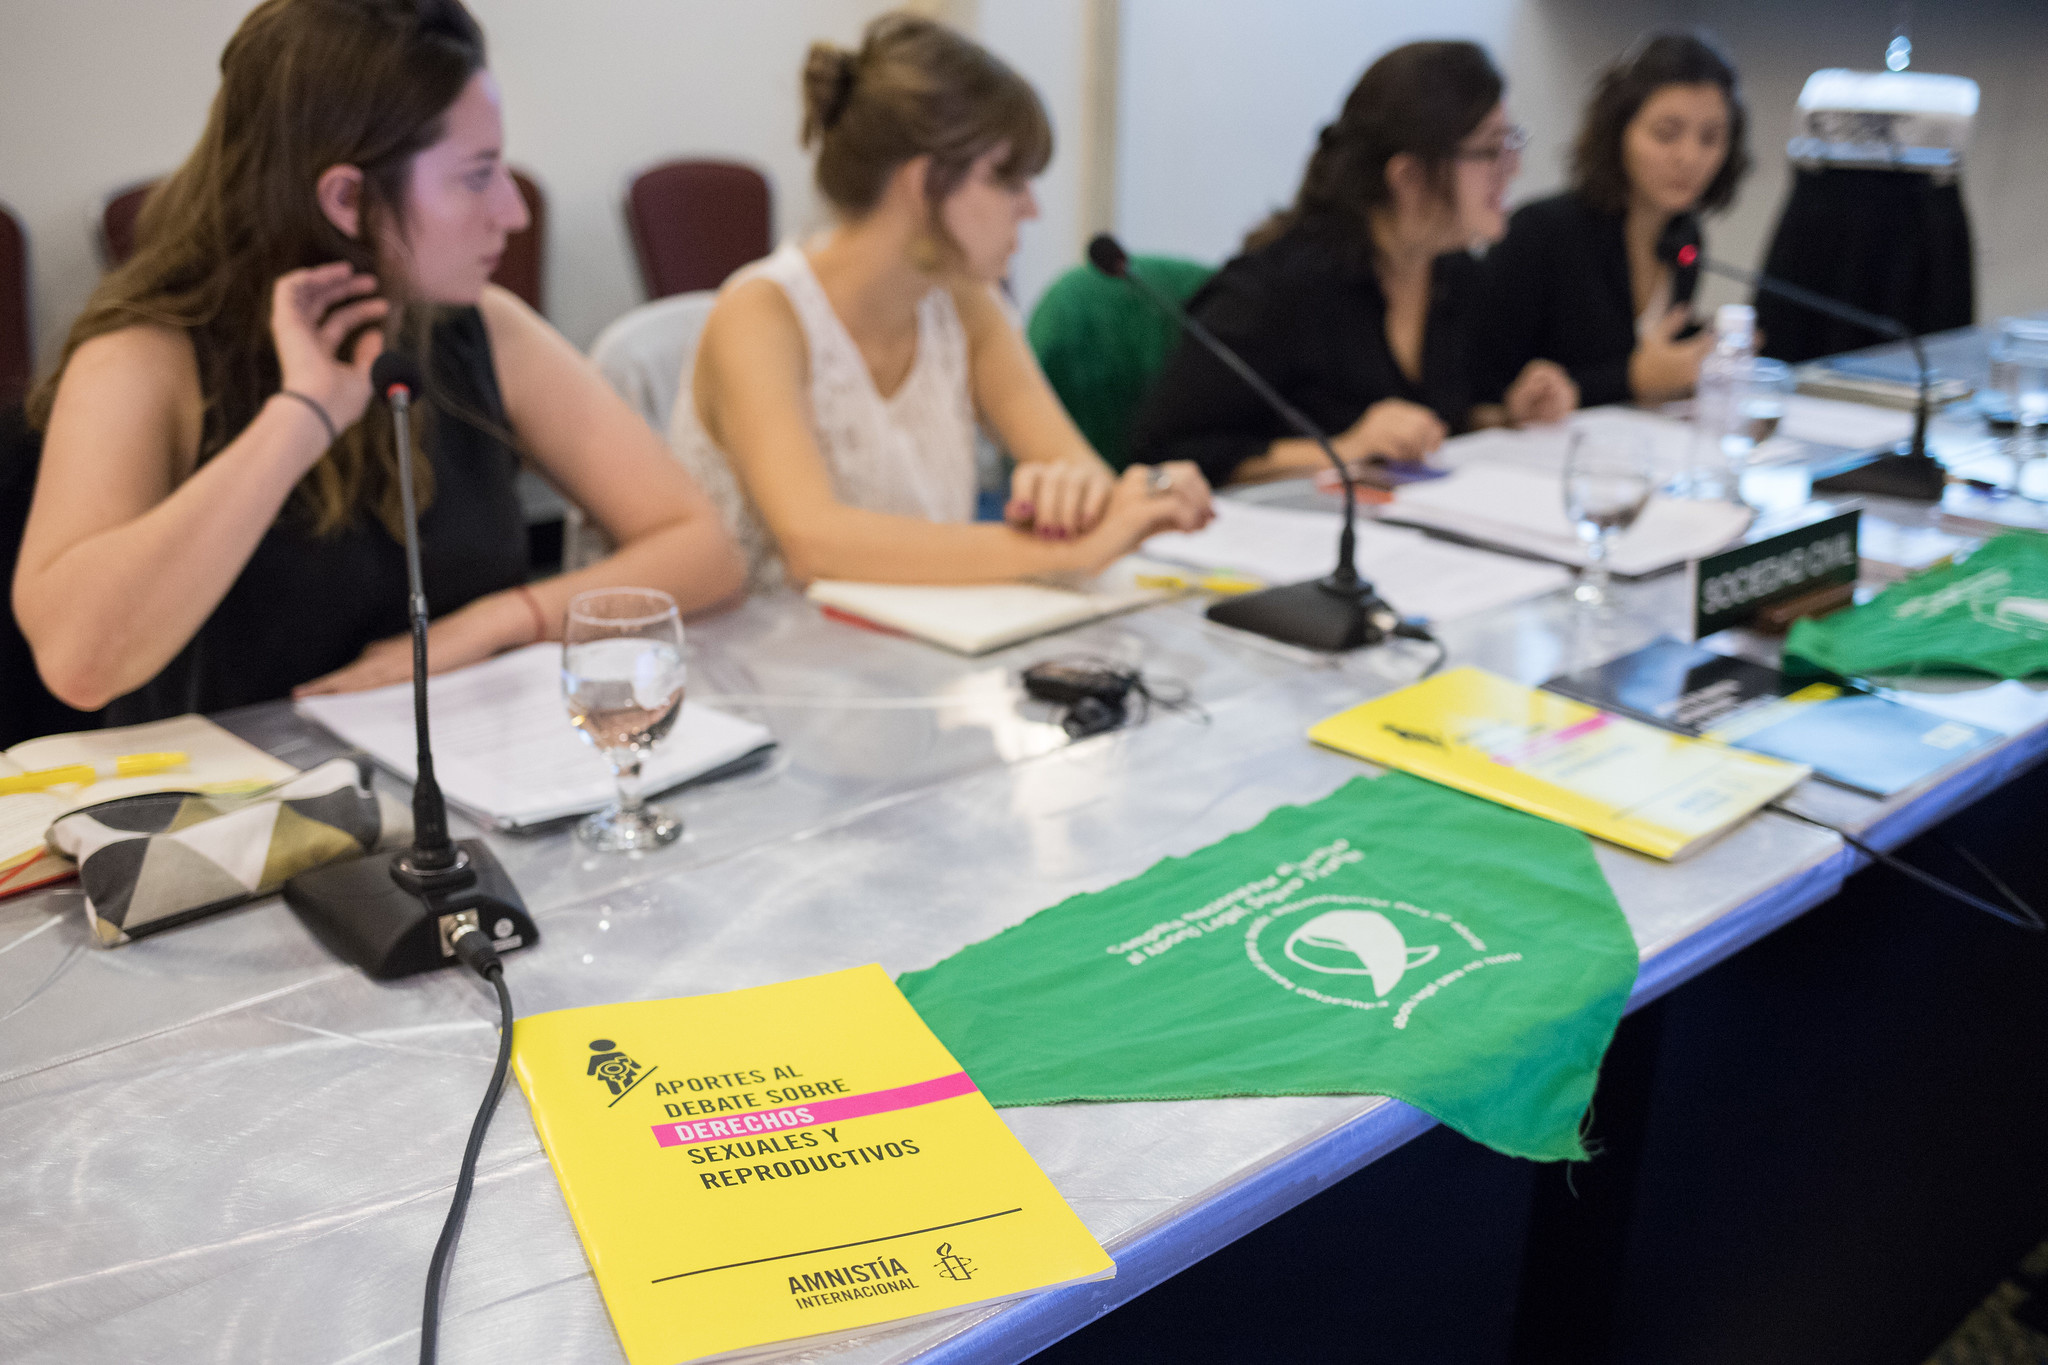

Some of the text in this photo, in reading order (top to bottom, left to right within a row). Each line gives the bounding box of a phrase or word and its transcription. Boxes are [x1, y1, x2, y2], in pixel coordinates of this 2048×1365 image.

[655, 1065, 804, 1096] APORTES AL
[664, 1078, 851, 1118] DEBATE SOBRE
[674, 1107, 816, 1142] DERECHOS
[687, 1127, 840, 1165] SEXUALES Y
[700, 1138, 921, 1190] REPRODUCTIVOS
[788, 1256, 909, 1295] AMNISTÍA
[796, 1278, 920, 1309] INTERNACIONAL
